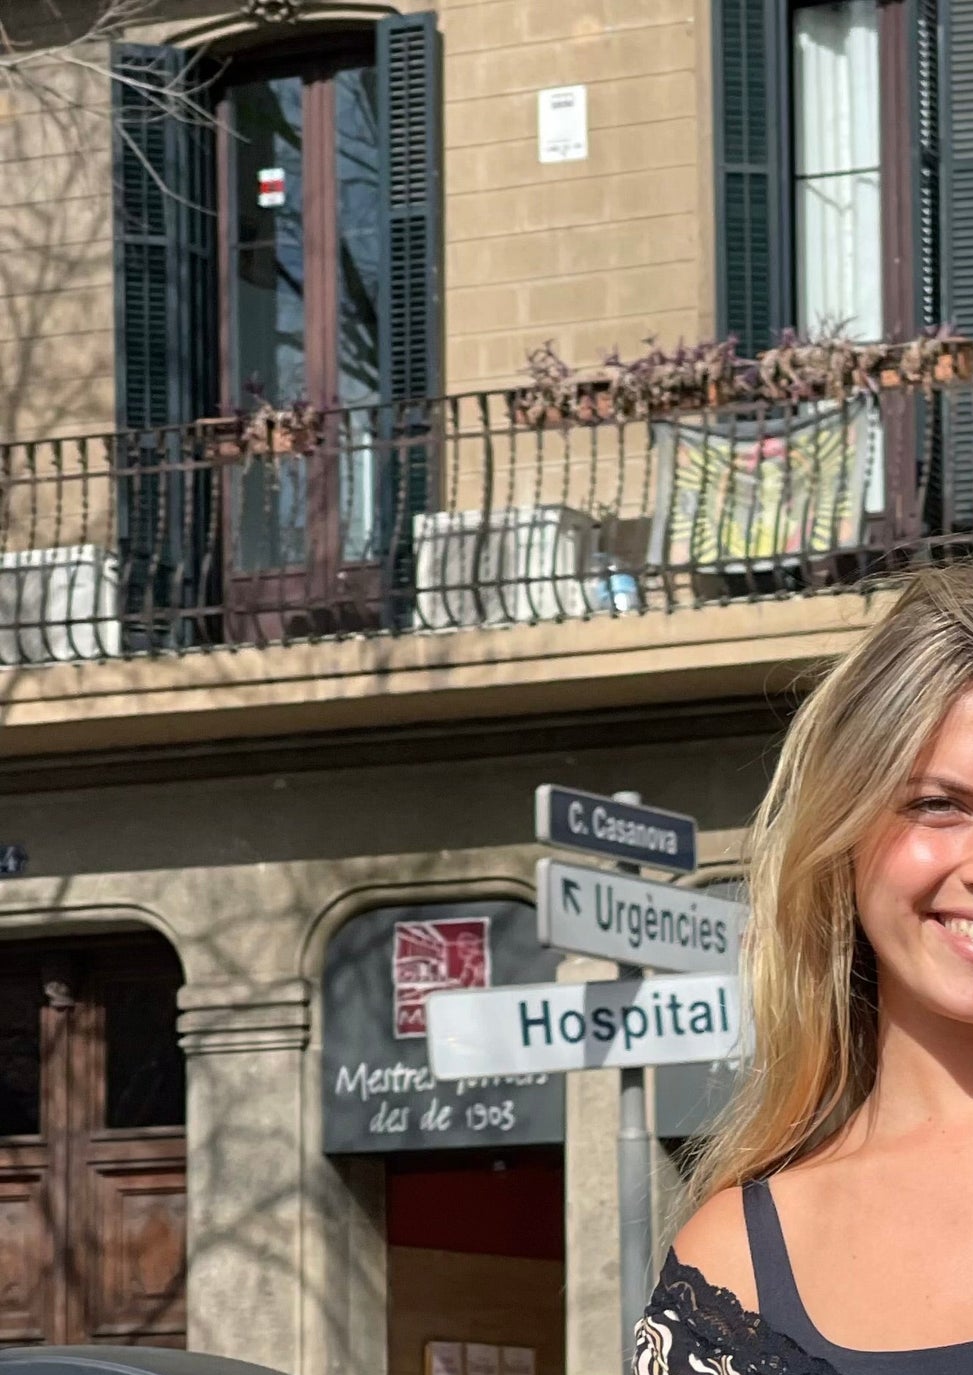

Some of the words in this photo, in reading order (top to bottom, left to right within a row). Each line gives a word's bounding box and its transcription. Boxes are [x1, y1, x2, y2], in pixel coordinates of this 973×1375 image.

[567, 800, 589, 836] C.
[591, 805, 679, 856] Casanova
[595, 883, 727, 954] Urgències
[518, 986, 729, 1051] Hospital
[369, 1100, 410, 1133] des
[420, 1097, 454, 1132] de
[464, 1099, 517, 1132] 1903
